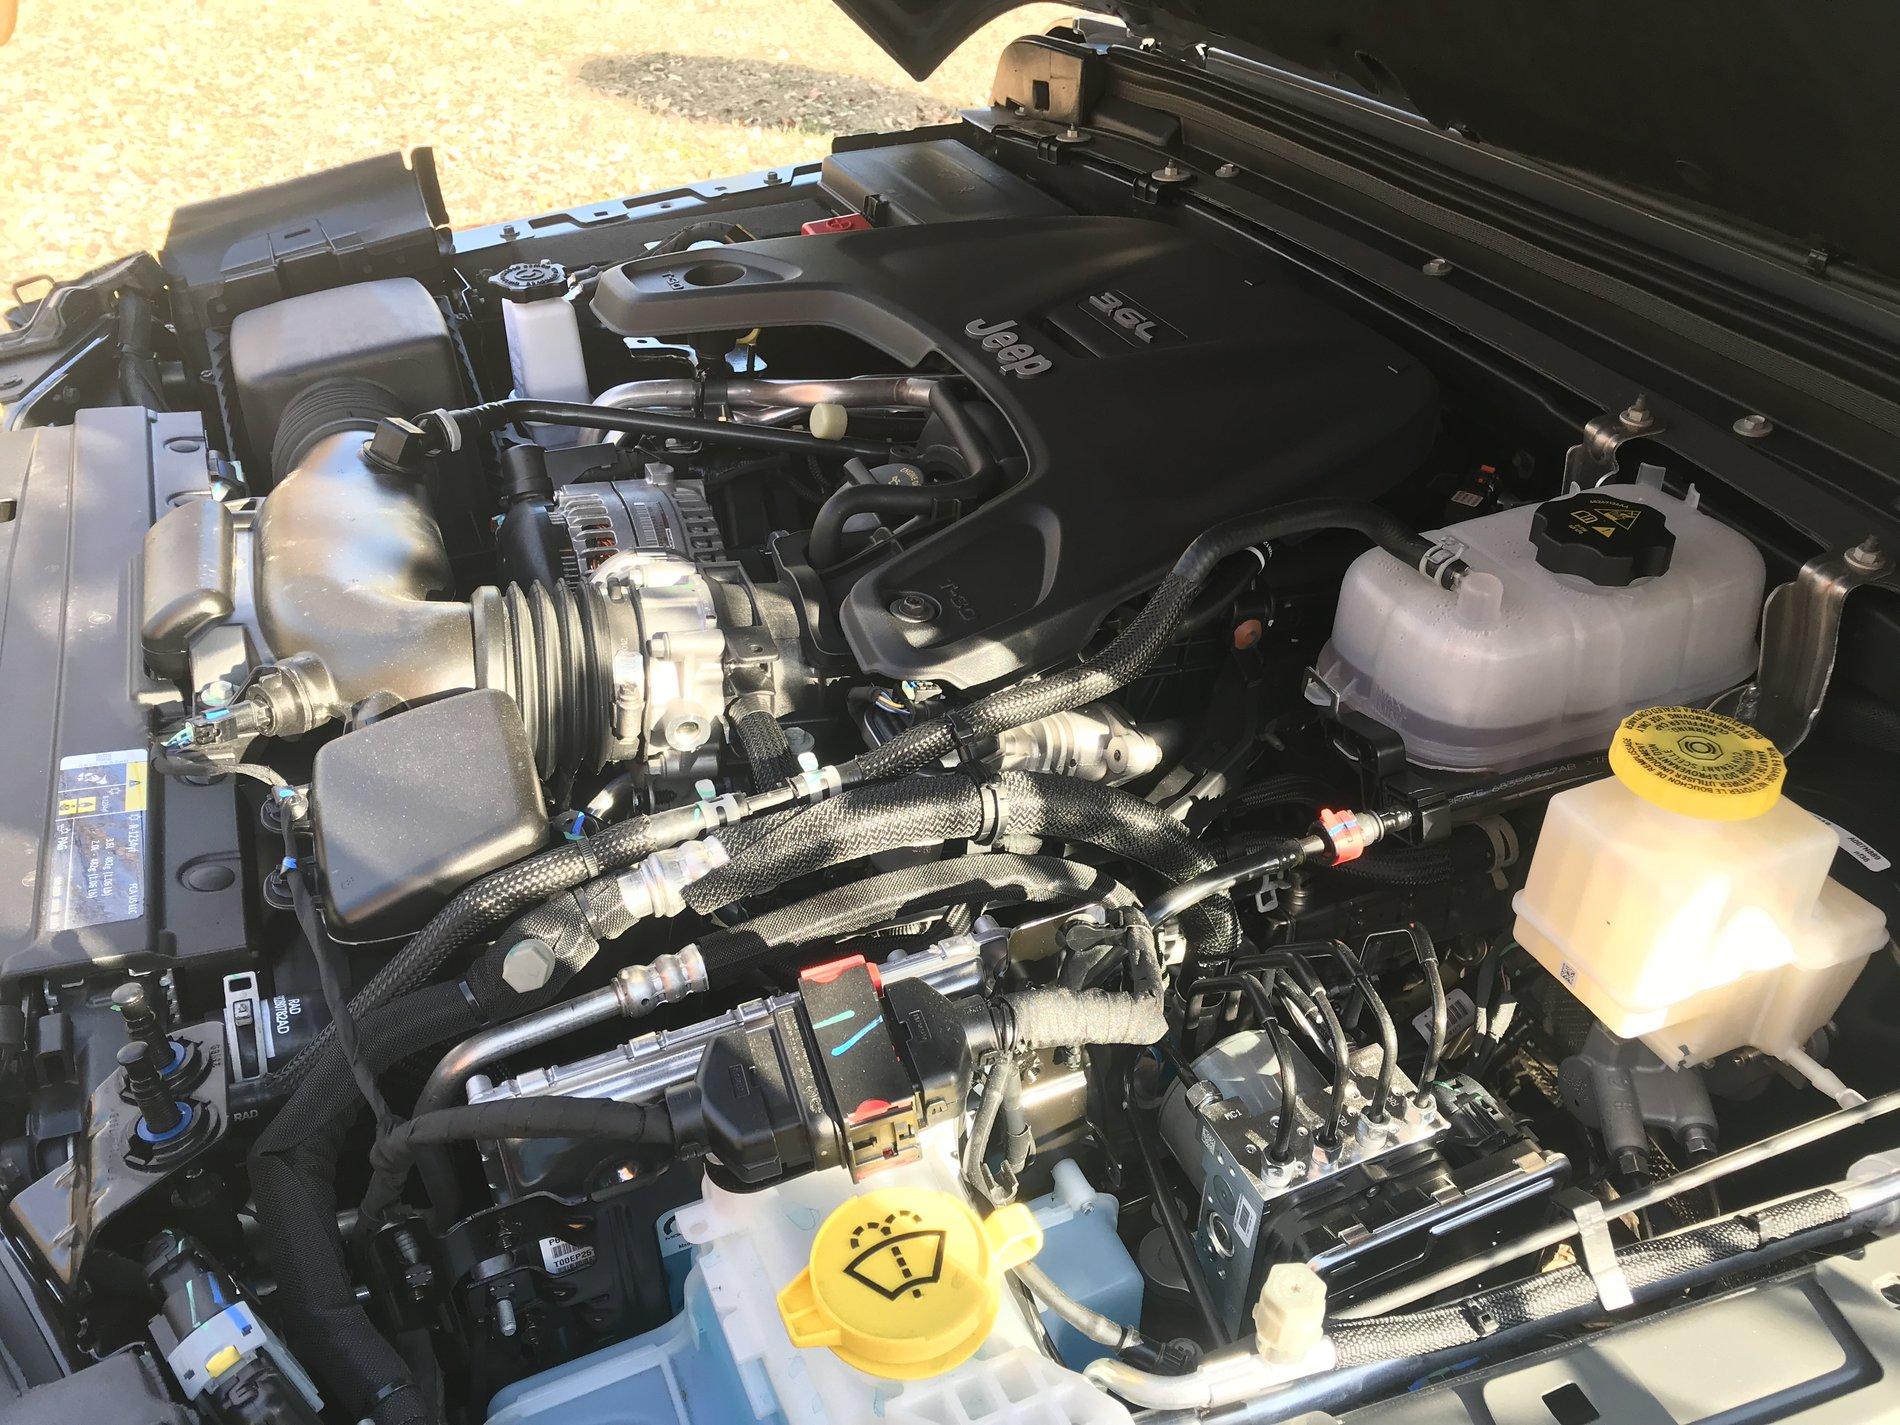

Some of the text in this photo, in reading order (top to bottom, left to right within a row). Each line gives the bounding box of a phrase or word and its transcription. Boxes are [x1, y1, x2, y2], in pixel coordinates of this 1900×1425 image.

[964, 318, 1053, 379] Jeep
[1650, 714, 1665, 723] USE
[1691, 709, 1715, 718] FROM
[1655, 722, 1668, 731] CAP
[1717, 716, 1740, 727] FLUID
[1700, 723, 1729, 735] CLEAN
[1717, 721, 1750, 739] BEFORE
[1745, 730, 1763, 739] DOT
[1635, 742, 1674, 775] UNIQUEMENT
[1658, 755, 1712, 780] PROVENANT
[1655, 770, 1668, 779] DE
[1675, 773, 1716, 787] UTILISER
[1721, 772, 1739, 780] DOT
[1668, 777, 1713, 793] BOUCHON
[57, 836, 68, 851] PAG
[128, 882, 138, 895] FCA
[288, 998, 301, 1015] RAD
[233, 1109, 258, 1122] RAD
